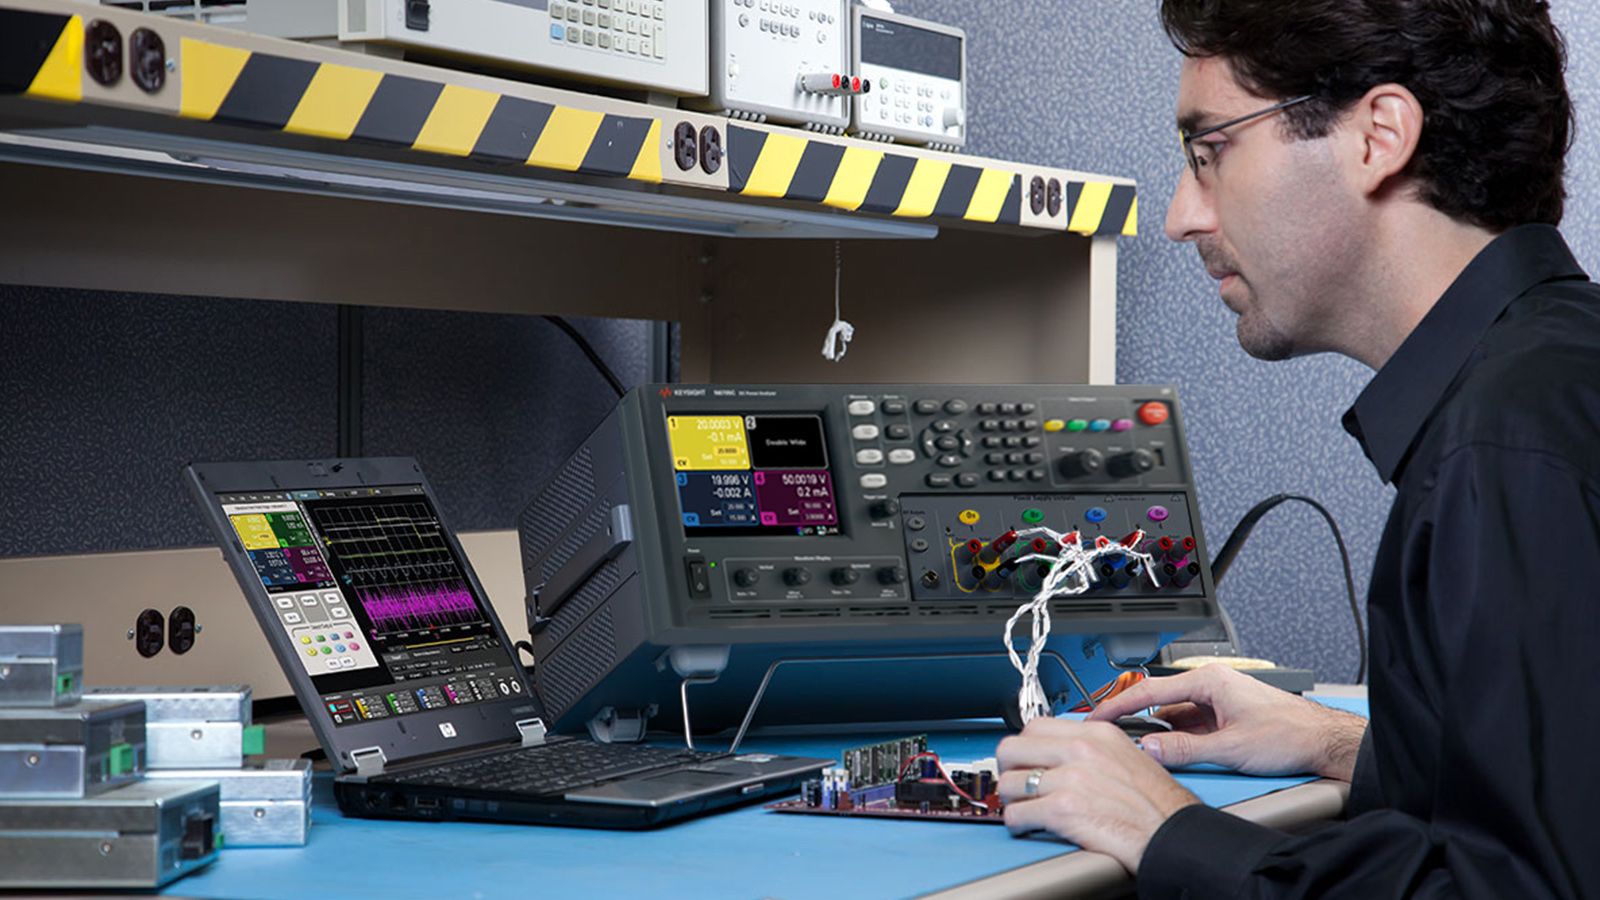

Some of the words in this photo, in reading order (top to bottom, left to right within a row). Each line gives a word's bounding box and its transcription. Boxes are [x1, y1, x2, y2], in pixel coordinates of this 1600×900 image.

[670, 418, 676, 428] 1
[697, 419, 732, 430] 20.0003
[733, 420, 741, 429] V
[707, 432, 724, 442] -0.1
[726, 433, 742, 442] mA
[789, 438, 807, 447] Wide
[711, 474, 740, 485] 19.996
[741, 475, 749, 485] V
[782, 474, 817, 485] 50.0019
[818, 474, 826, 484] V
[712, 487, 742, 498] -0.002
[743, 487, 752, 497] A
[797, 486, 811, 497] 0.2
[812, 487, 829, 496] mA
